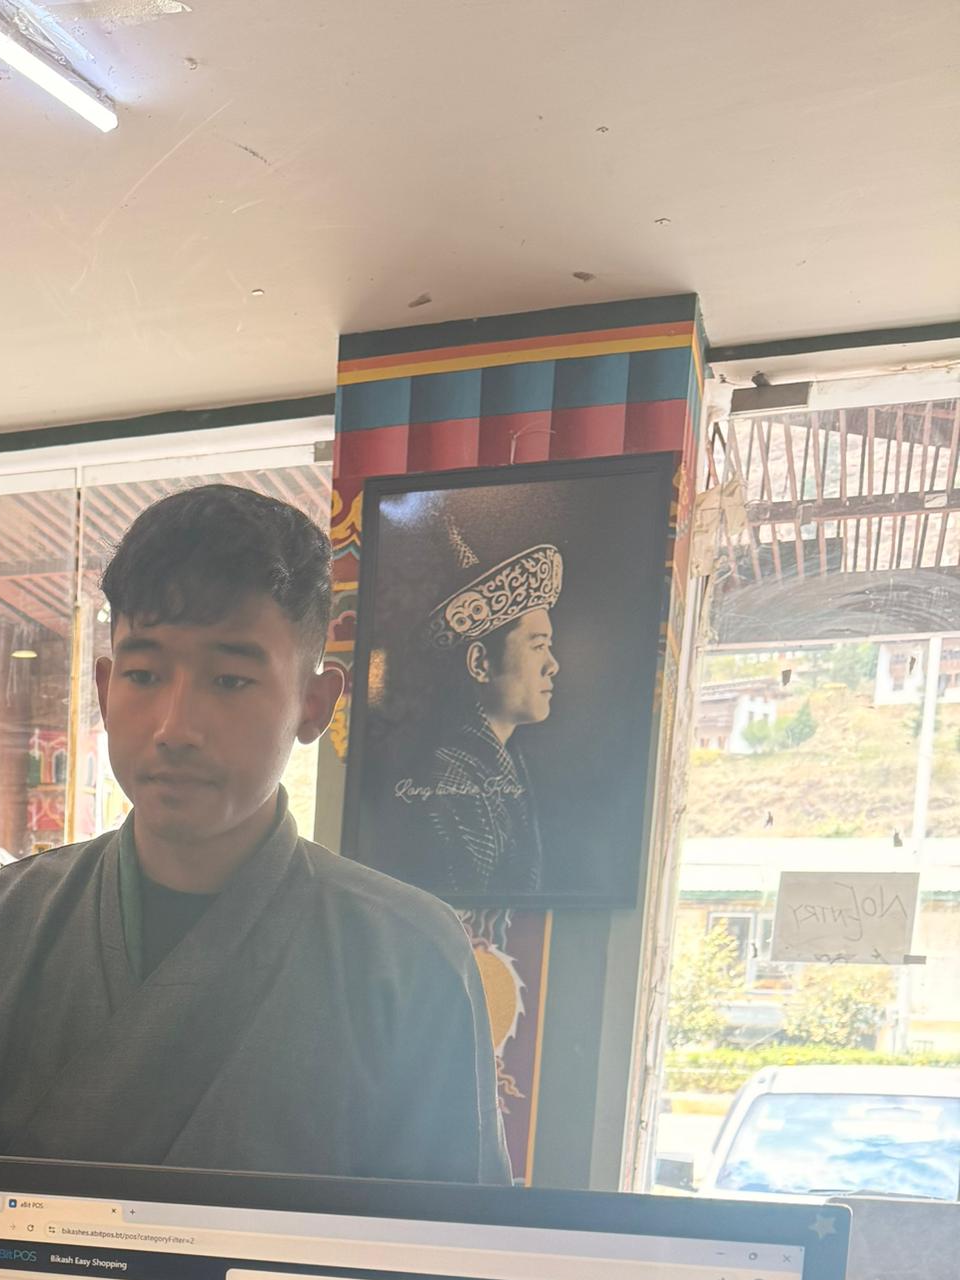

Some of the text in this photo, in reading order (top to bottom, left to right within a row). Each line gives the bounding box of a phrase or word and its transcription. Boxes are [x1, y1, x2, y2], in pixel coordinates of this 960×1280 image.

[50, 1254, 128, 1270] Bikash Easy Shopping
